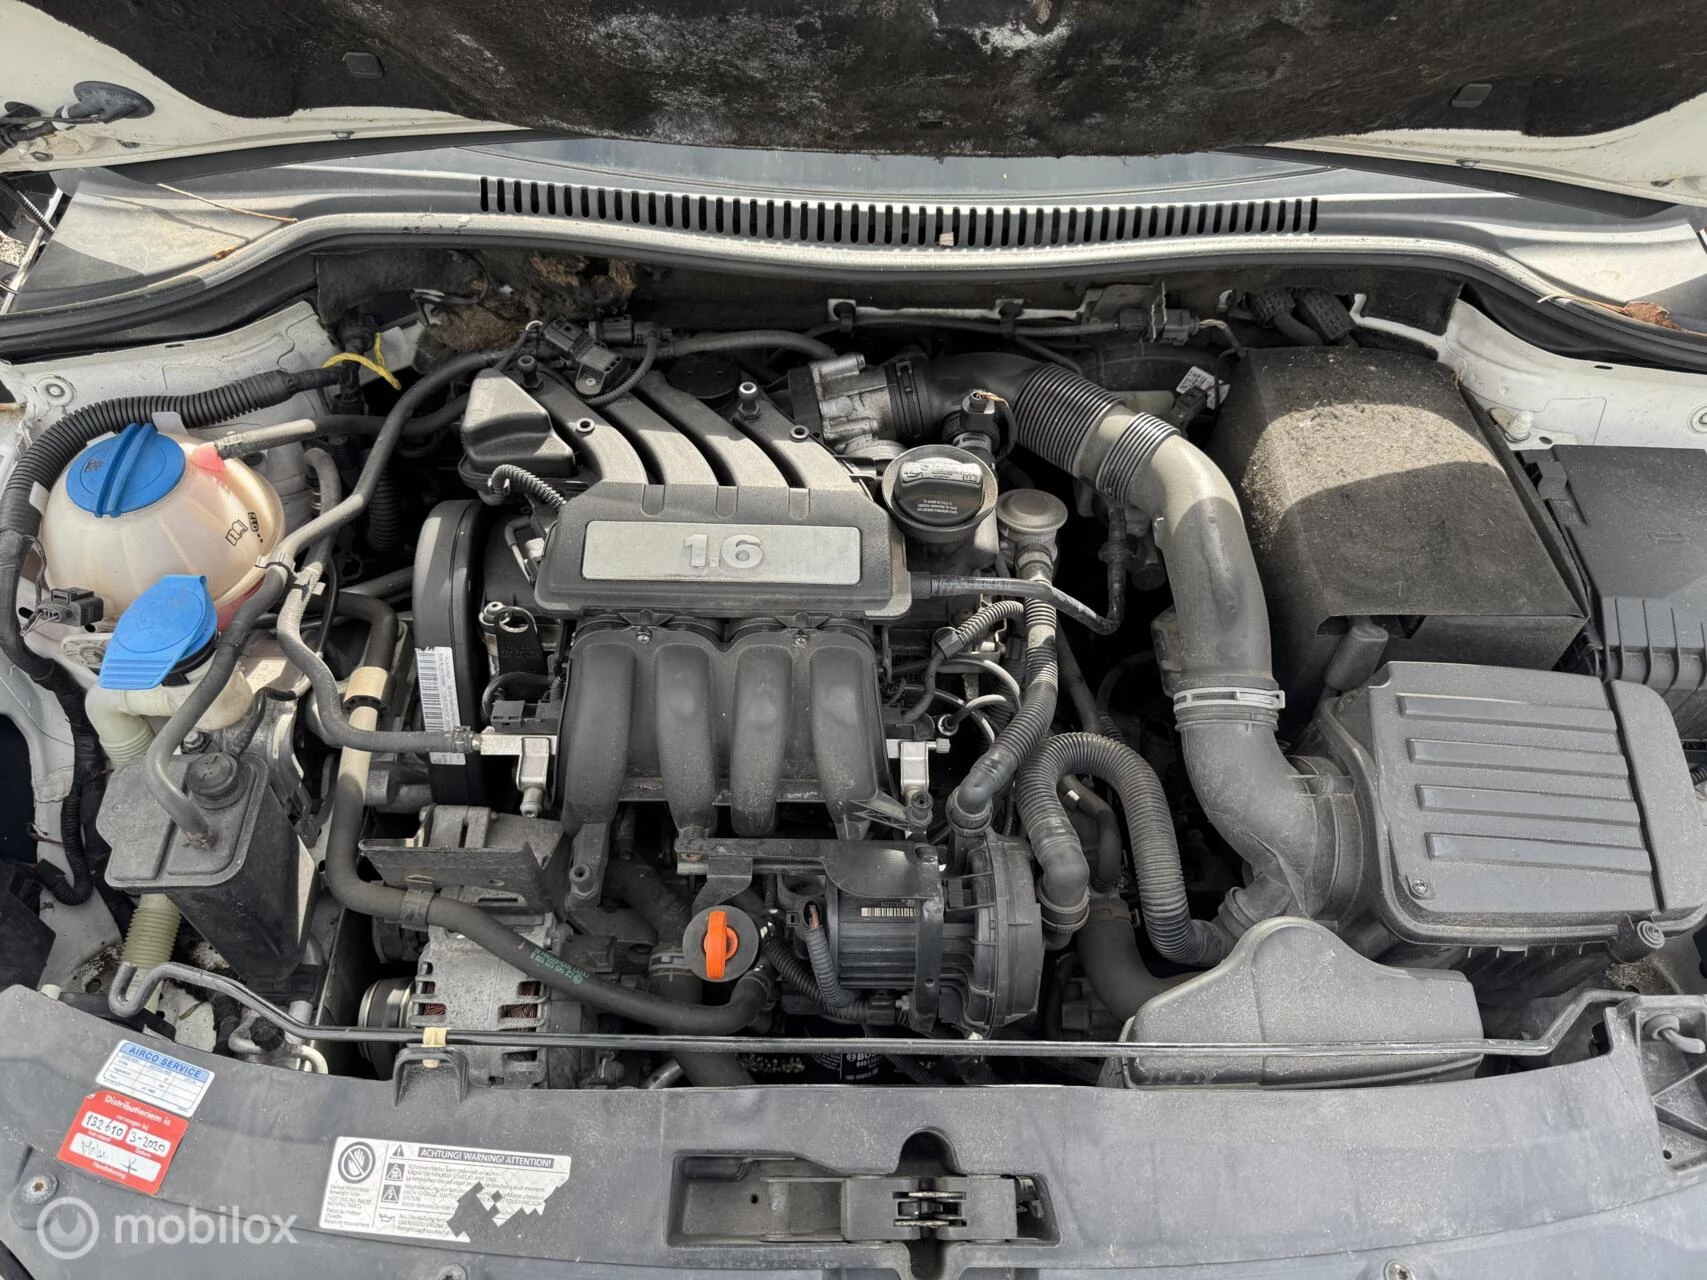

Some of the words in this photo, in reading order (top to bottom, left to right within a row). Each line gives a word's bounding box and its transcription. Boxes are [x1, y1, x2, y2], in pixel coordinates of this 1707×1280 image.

[683, 534, 764, 569] 1.6
[129, 1047, 159, 1062] AIRCO
[161, 1058, 202, 1078] SERVICE
[163, 1117, 172, 1127] is
[129, 1128, 166, 1153] 3-2020
[421, 1148, 462, 1160] ACHTUNG!
[463, 1151, 505, 1163] WARNING!
[505, 1155, 552, 1167] ATTENTION!
